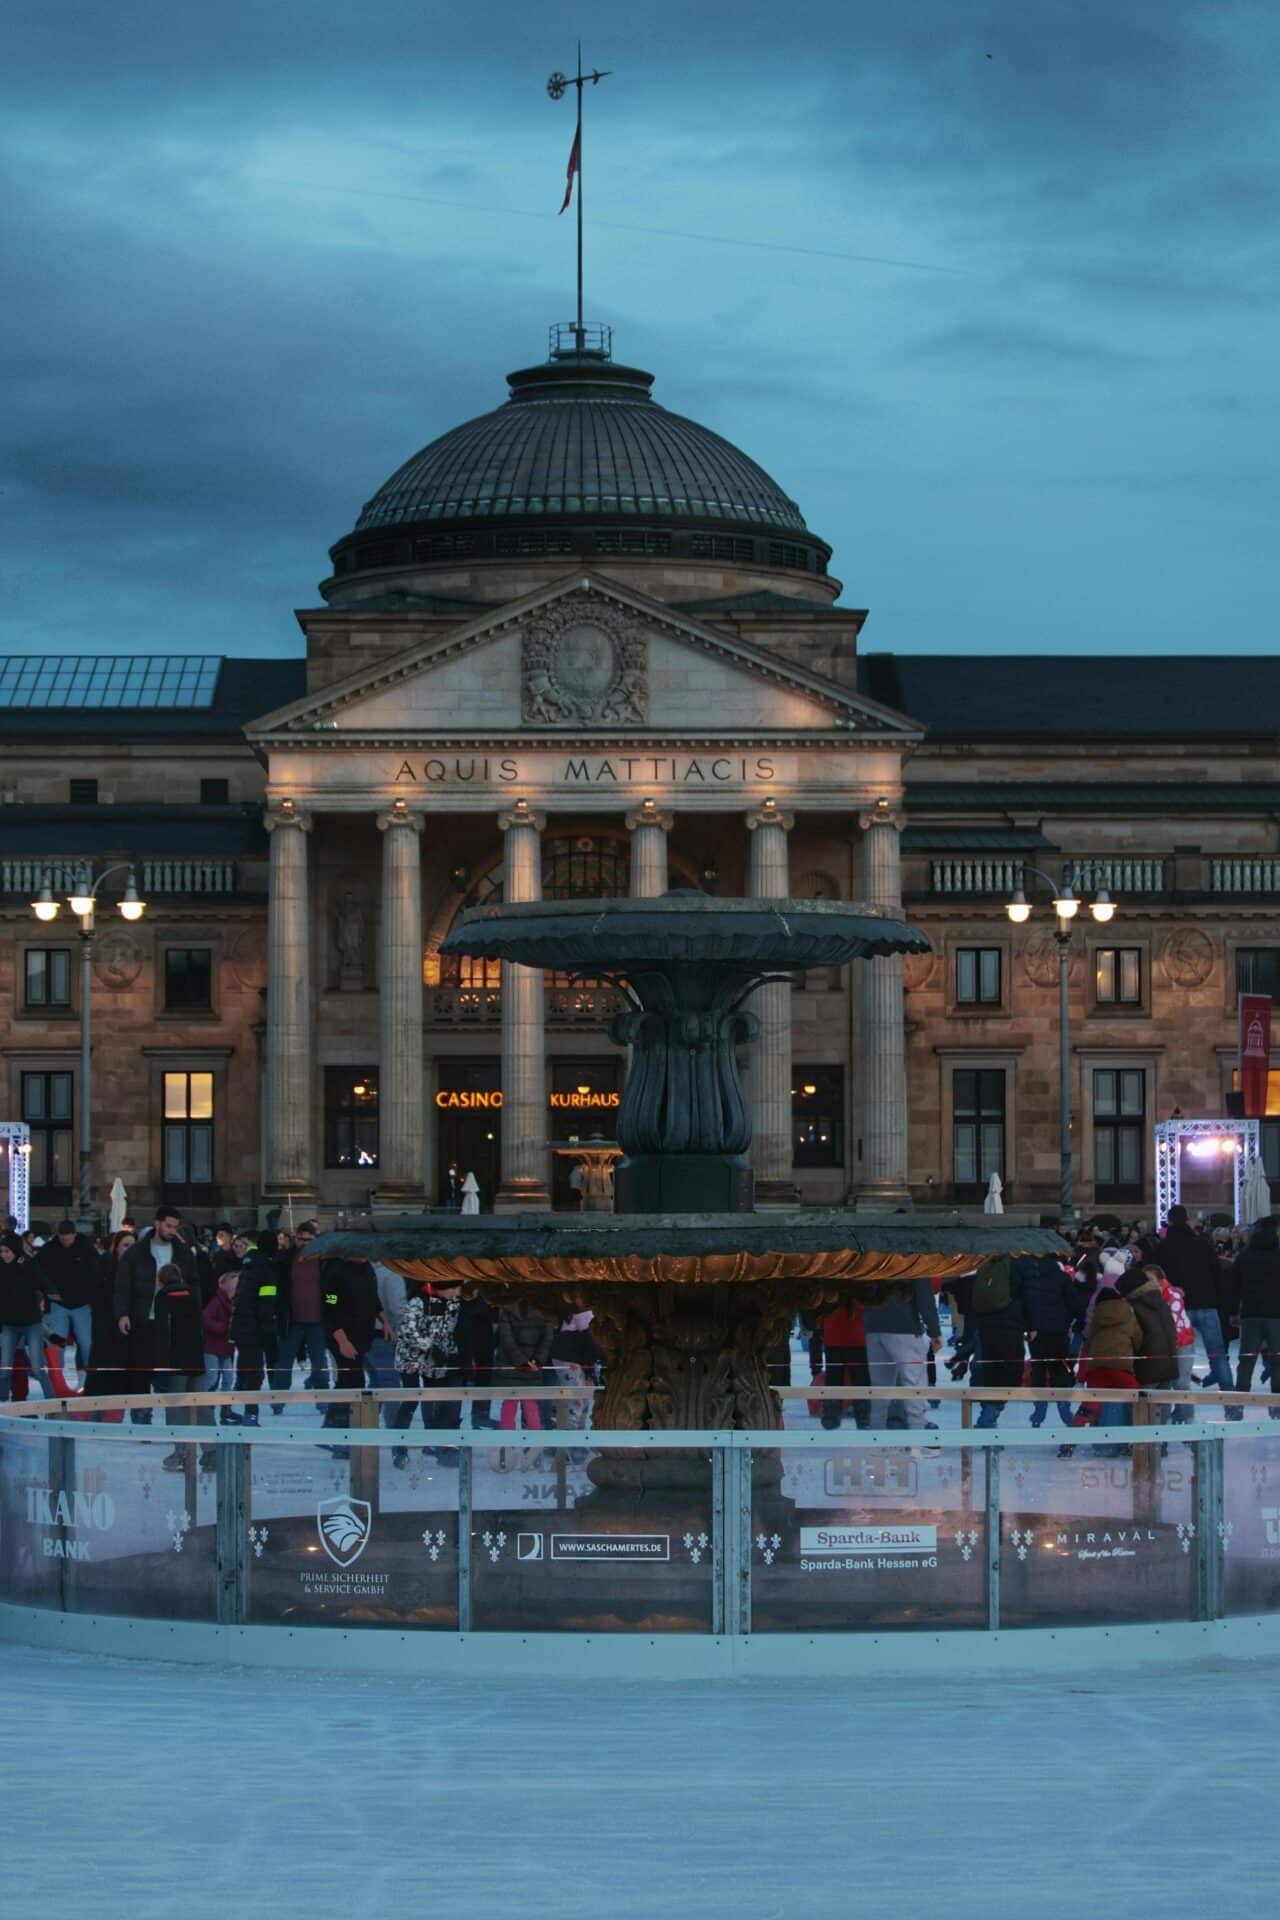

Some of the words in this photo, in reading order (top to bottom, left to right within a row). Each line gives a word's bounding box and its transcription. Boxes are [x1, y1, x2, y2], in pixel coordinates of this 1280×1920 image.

[395, 759, 519, 784] AQUIS
[564, 757, 776, 783] MATTIACIS
[436, 1091, 504, 1109] CASINO
[550, 1092, 620, 1107] KURHAUS
[26, 1487, 115, 1530] IKANO
[817, 1531, 921, 1547] Sparda-Bank
[1057, 1530, 1155, 1544] MIRAVAL
[43, 1538, 91, 1561] BANK
[559, 1543, 662, 1552] WWW.SASCHAMERTES.DE
[800, 1558, 874, 1572] Sparda-Bank
[877, 1558, 918, 1569] Hessen
[921, 1557, 937, 1567] eG
[300, 1573, 329, 1582] PRIME
[331, 1573, 390, 1584] SICHERHEIT
[304, 1584, 312, 1593] &
[314, 1584, 352, 1594] SERVICE
[353, 1585, 385, 1595] GMBH
